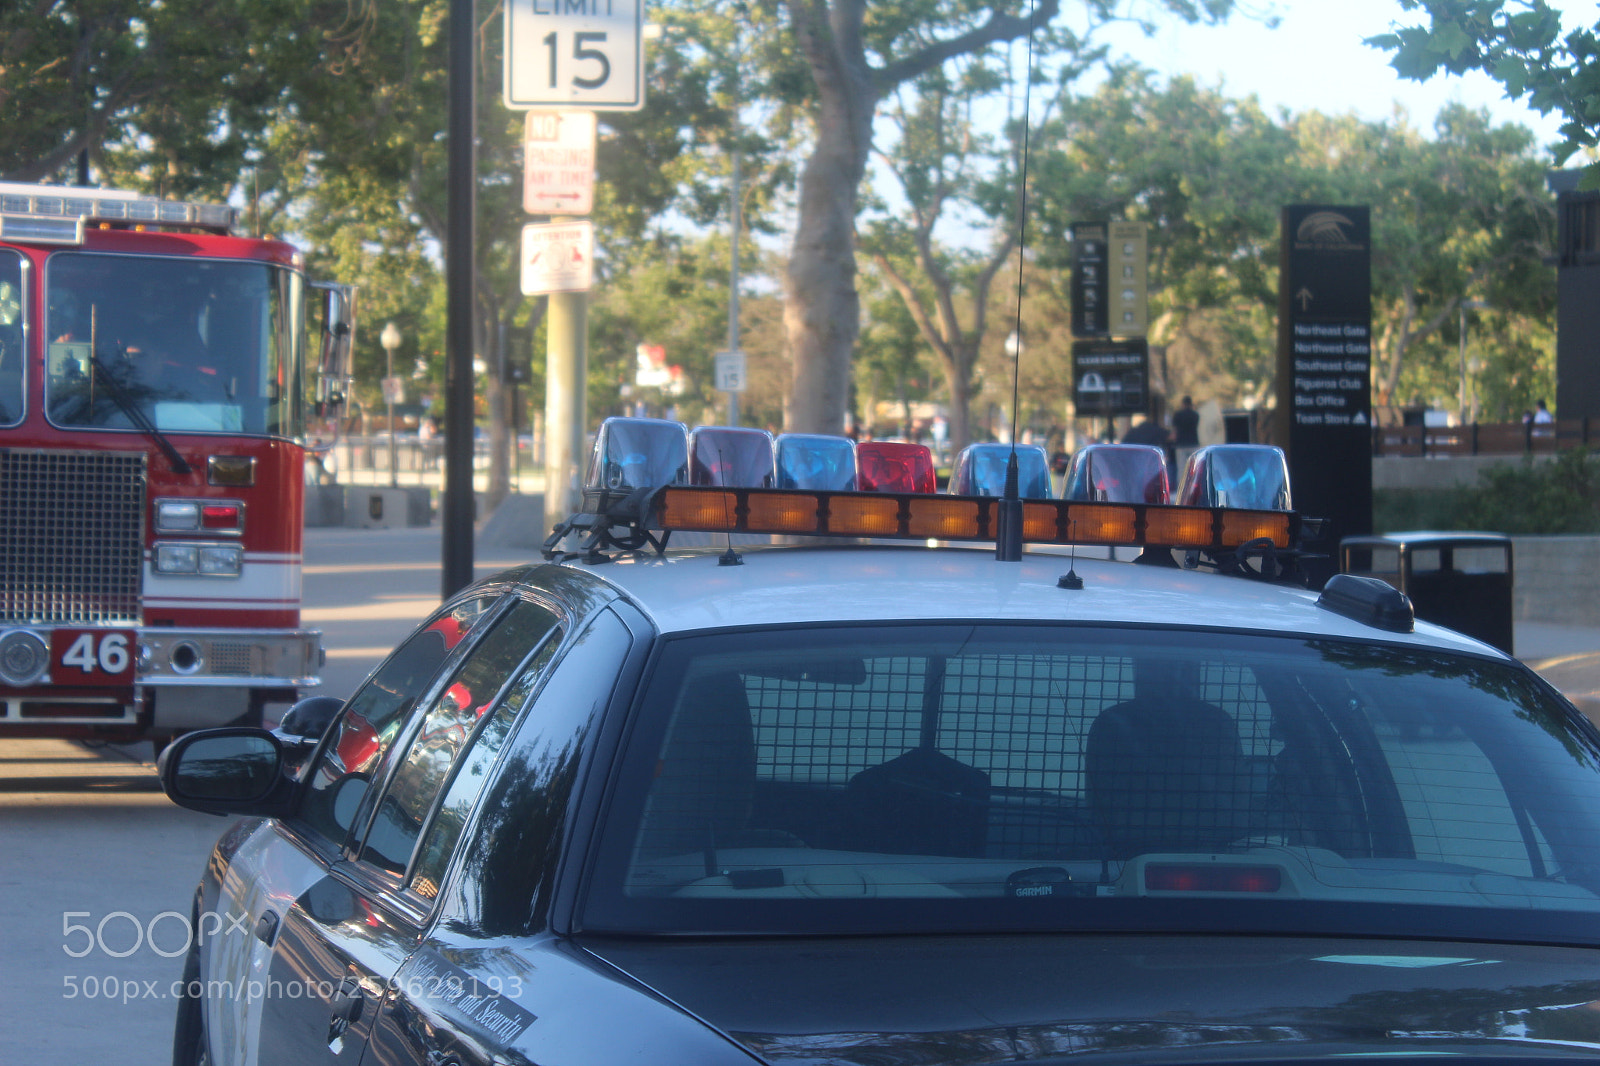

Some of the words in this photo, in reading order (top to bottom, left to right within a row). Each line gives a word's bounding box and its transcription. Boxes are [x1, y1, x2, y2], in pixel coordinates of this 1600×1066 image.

[543, 31, 611, 90] 15
[1295, 325, 1342, 336] Northeast
[1344, 325, 1366, 337] Gate
[1295, 343, 1344, 354] Northwest
[1346, 343, 1368, 355] Gate
[1295, 360, 1342, 371] Southeast
[1344, 360, 1367, 372] Gate
[1295, 378, 1337, 391] Figueroa
[1339, 378, 1361, 390] Club
[1295, 395, 1314, 406] Box
[1316, 395, 1346, 406] Office
[1296, 413, 1323, 425] Team
[1325, 413, 1350, 425] Store
[62, 633, 130, 674] 46
[1016, 885, 1053, 897] GARMIN
[456, 994, 491, 1016] and
[474, 999, 523, 1045] Security
